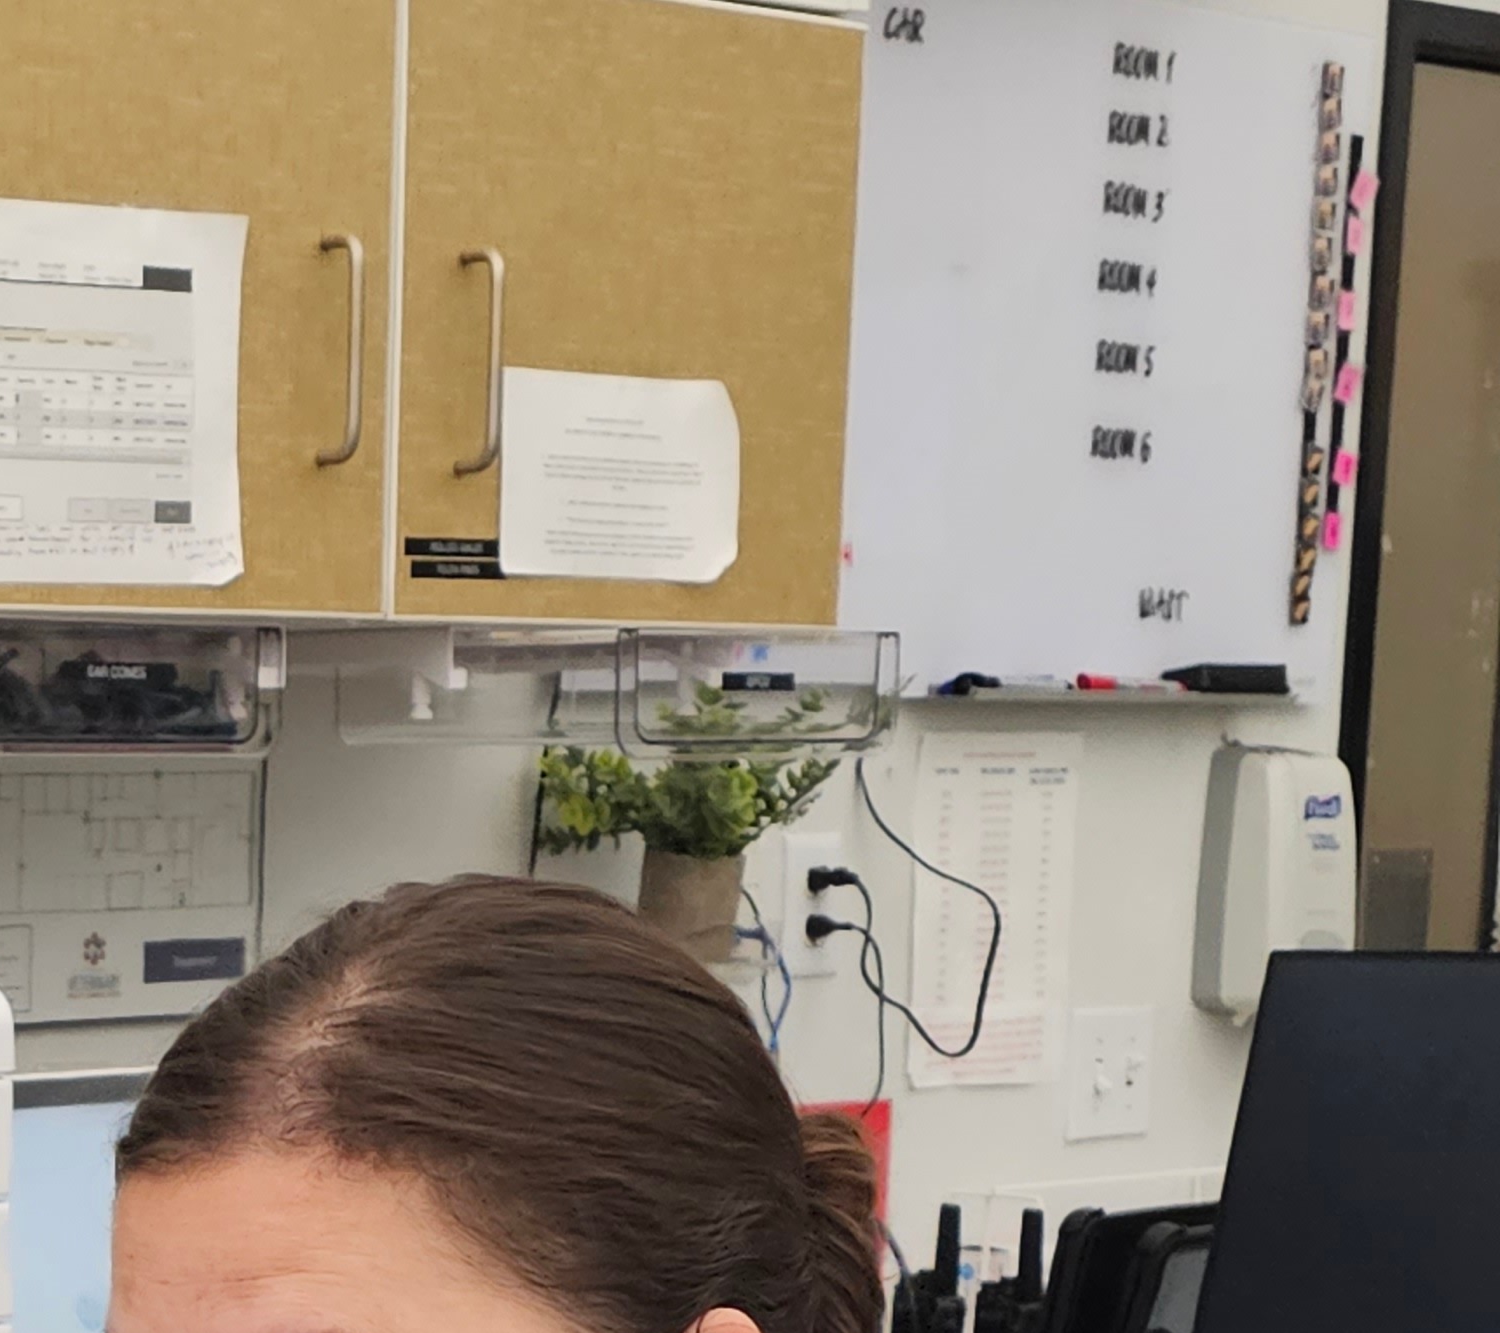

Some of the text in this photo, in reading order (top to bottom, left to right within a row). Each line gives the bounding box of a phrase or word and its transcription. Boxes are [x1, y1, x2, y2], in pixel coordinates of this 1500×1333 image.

[884, 7, 925, 44] CAR
[1112, 41, 1177, 83] ROOM 1
[1107, 110, 1169, 147] ROOM 2
[1103, 180, 1164, 224] ROOM 3
[1098, 259, 1156, 298] ROOM 4
[1096, 339, 1155, 377] ROOM 5
[1091, 425, 1153, 465] ROOM 6
